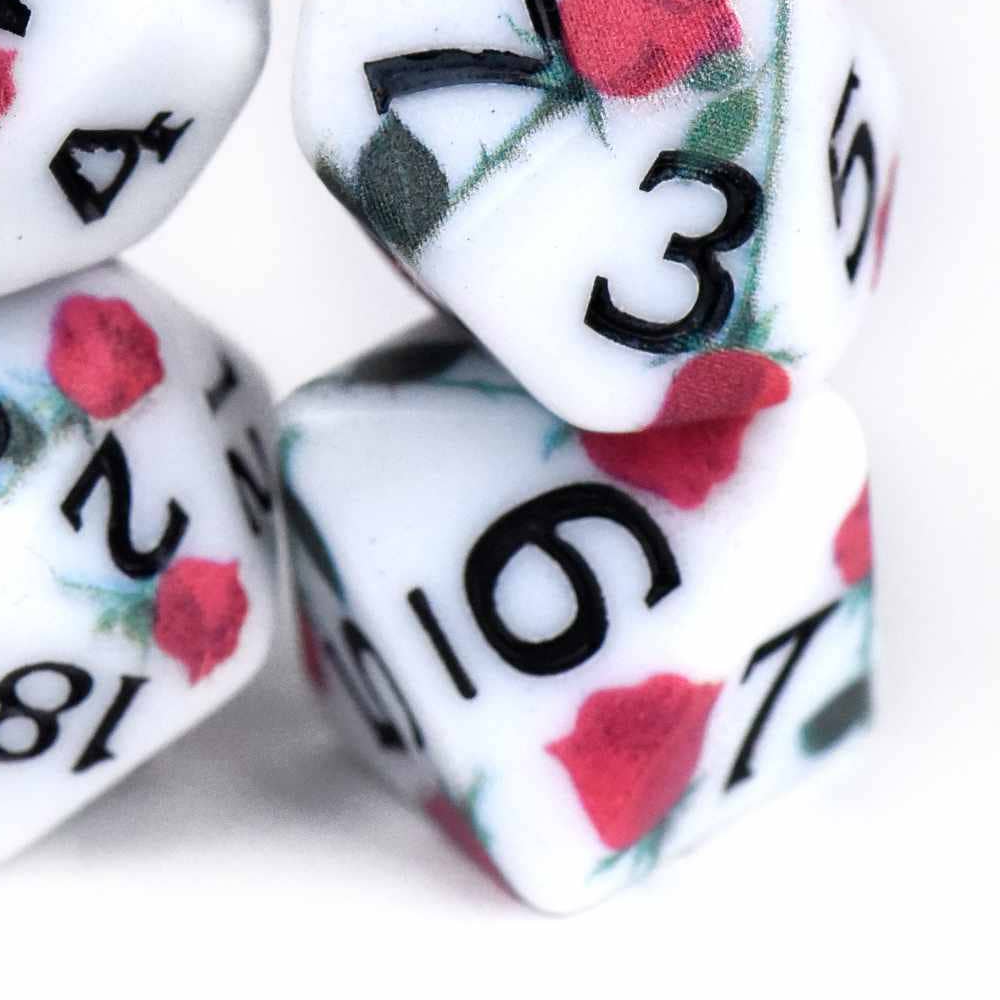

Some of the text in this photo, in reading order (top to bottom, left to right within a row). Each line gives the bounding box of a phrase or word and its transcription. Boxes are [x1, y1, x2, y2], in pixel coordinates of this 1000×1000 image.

[49, 111, 194, 223] 4
[583, 149, 765, 355] 3
[828, 58, 876, 284] 5
[61, 431, 189, 580] 2
[463, 481, 681, 676] 6
[725, 600, 842, 793] 7
